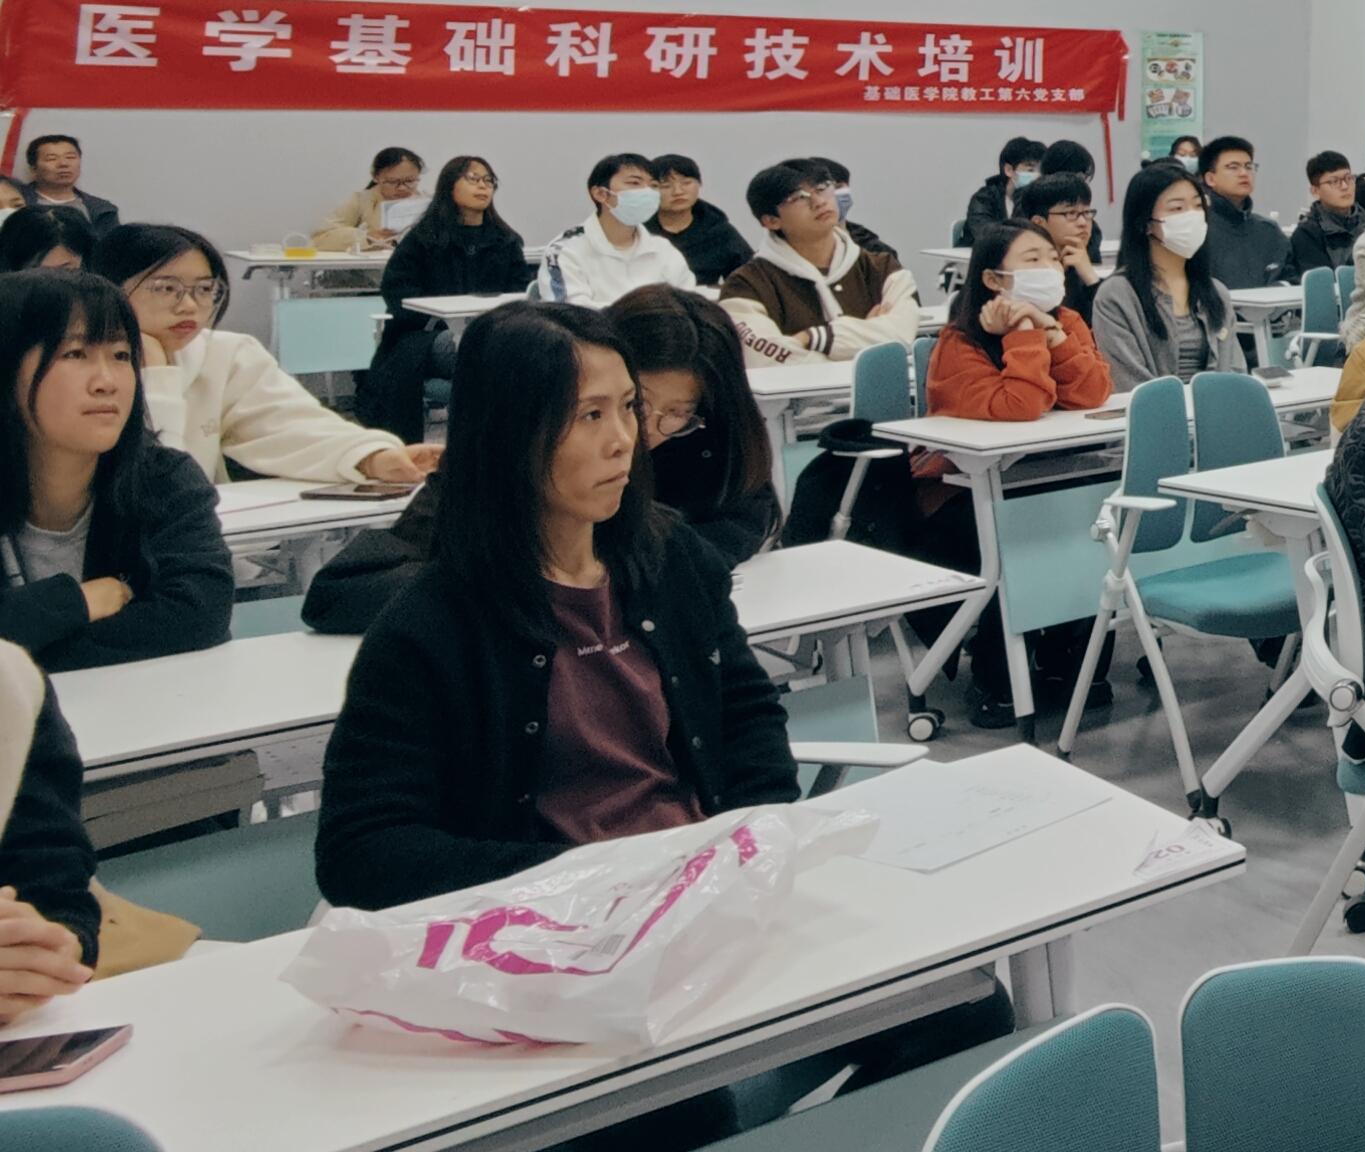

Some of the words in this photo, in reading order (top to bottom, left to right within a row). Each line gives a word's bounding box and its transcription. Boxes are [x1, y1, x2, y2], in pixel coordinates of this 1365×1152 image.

[75, 3, 1044, 84] 医学基础科研技术培训
[864, 85, 1085, 102] 基础医学院教工第六党支部
